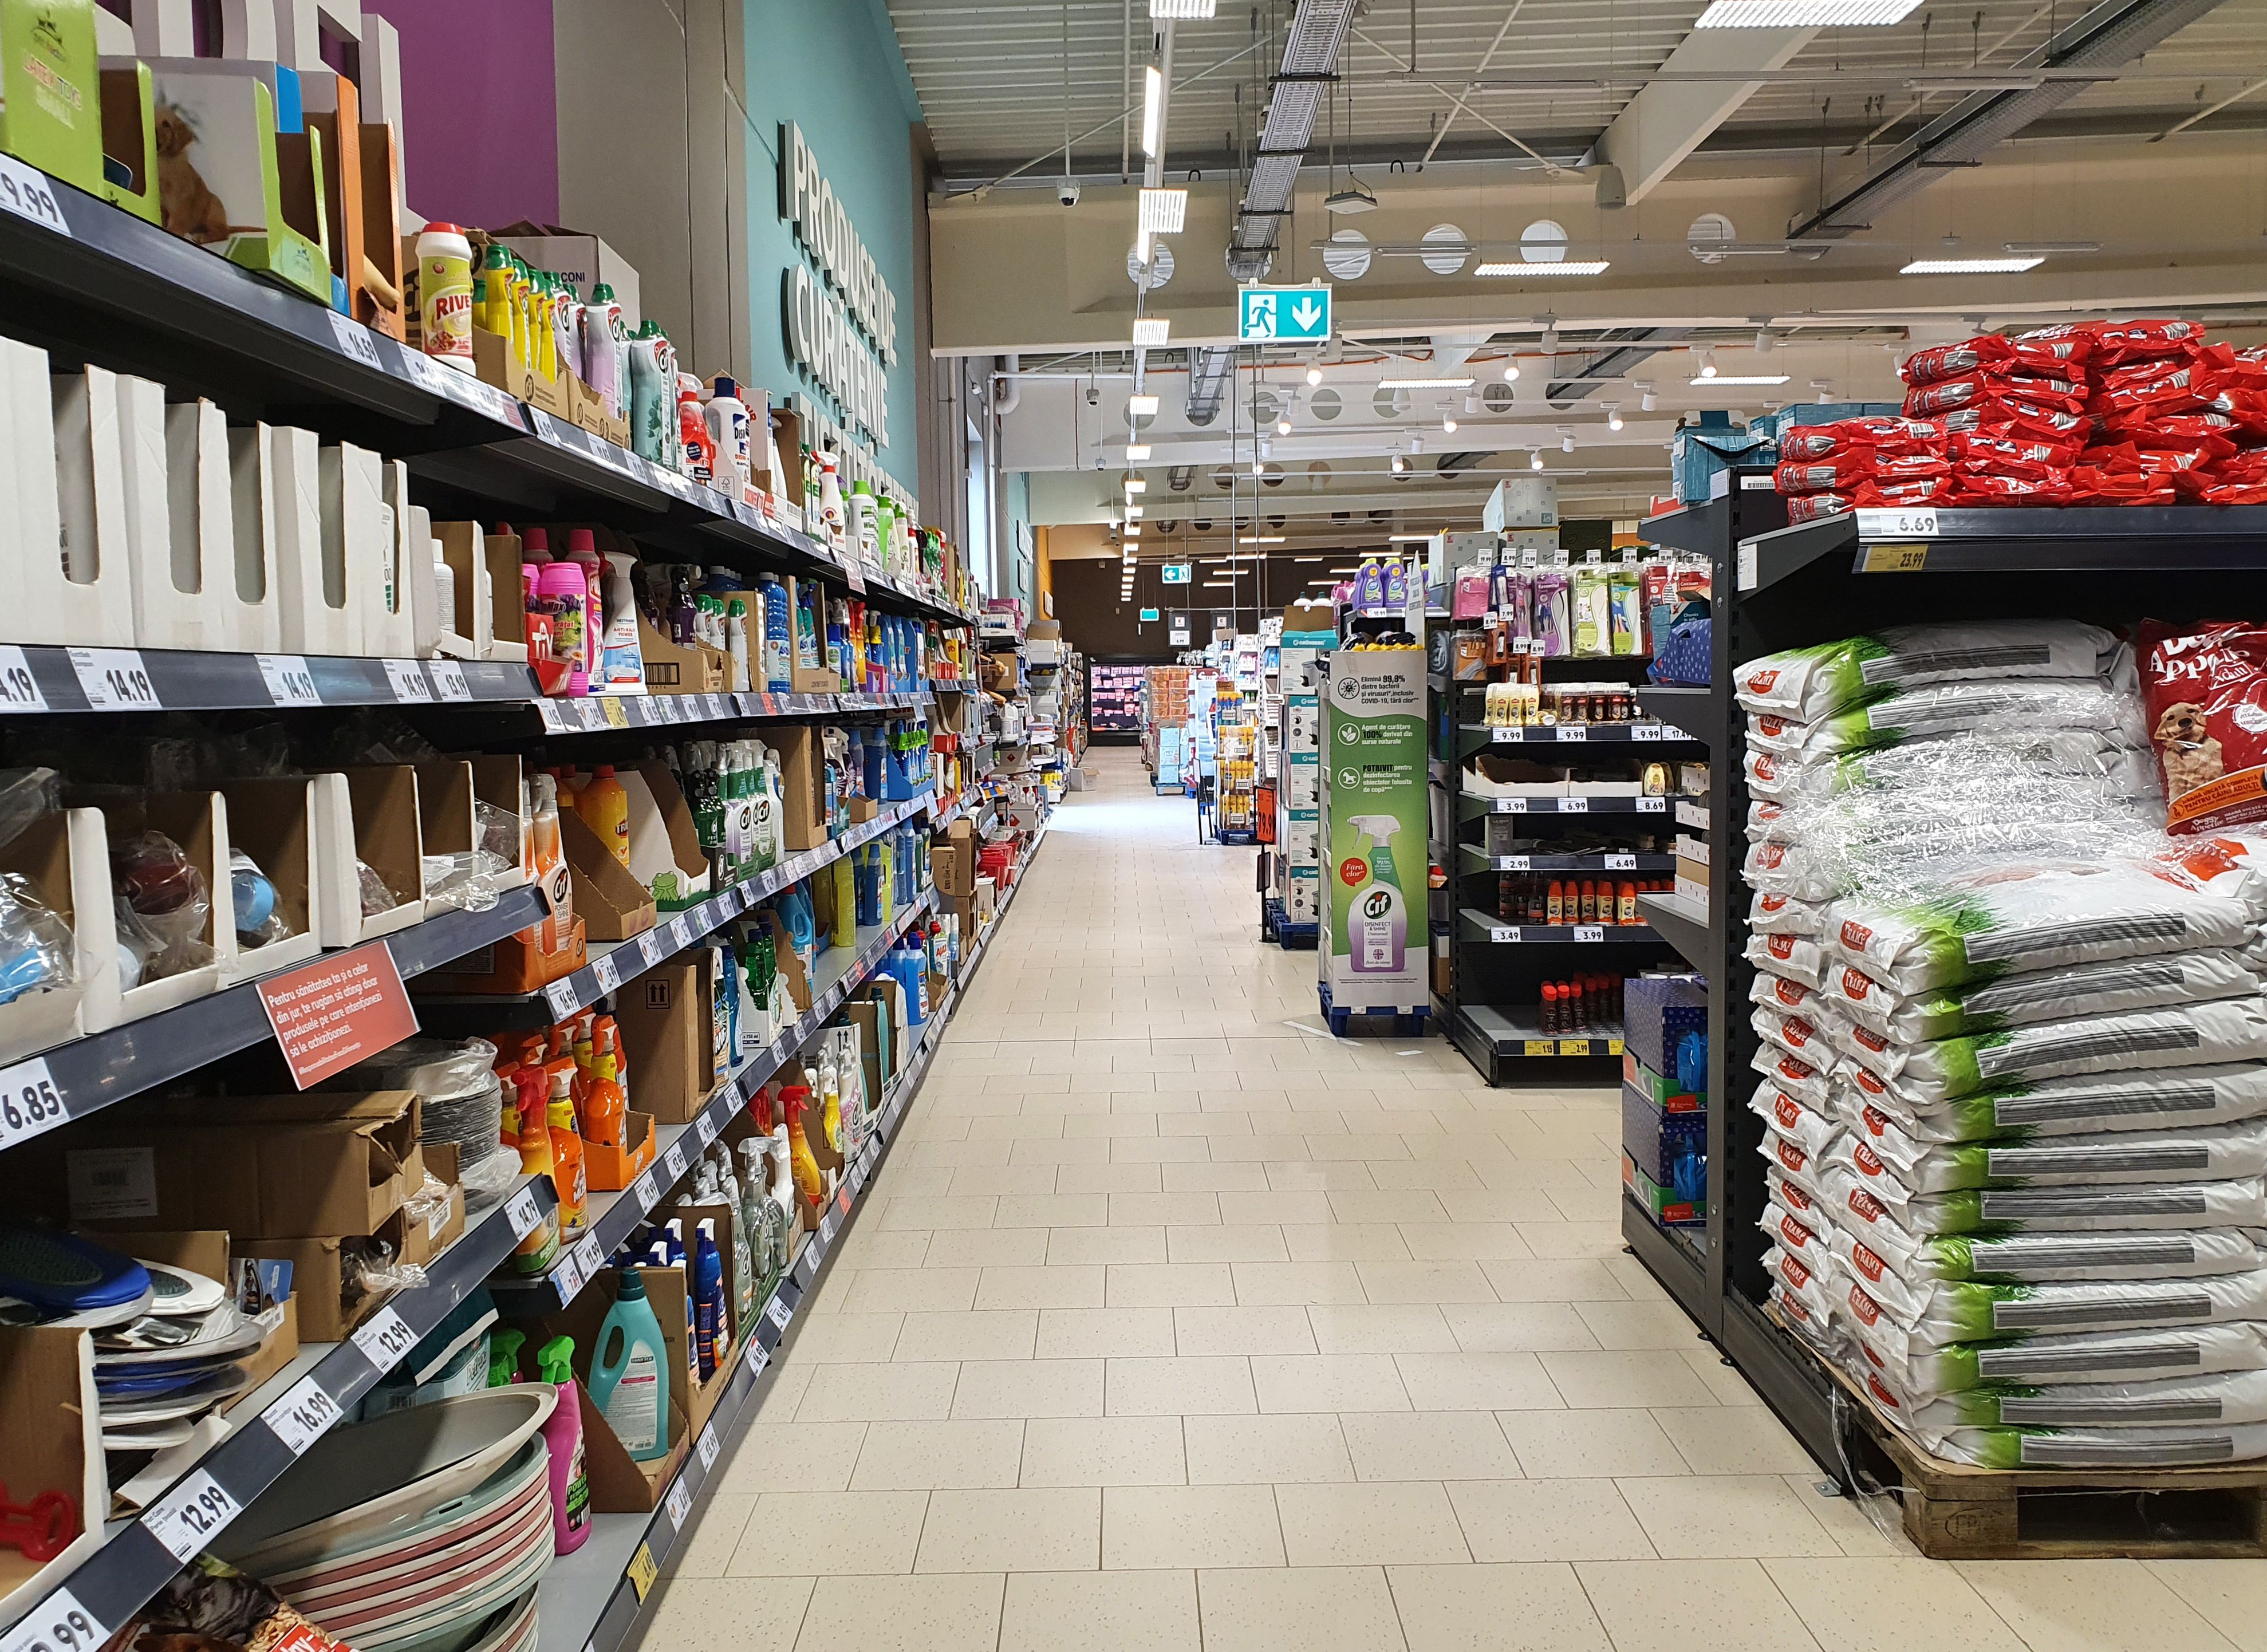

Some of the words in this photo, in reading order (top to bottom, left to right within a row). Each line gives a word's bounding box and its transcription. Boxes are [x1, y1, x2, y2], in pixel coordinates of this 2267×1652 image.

[784, 119, 878, 338] PRODUSE
[876, 272, 897, 368] DE
[561, 272, 585, 282] CONI
[436, 294, 471, 321] RIVE
[1899, 517, 1934, 532] 6.69
[1900, 552, 1924, 567] 23.99
[106, 669, 152, 701] 14.19
[282, 672, 315, 699] 14.19
[401, 673, 428, 696] 14.19
[1363, 730, 1382, 739] 100%
[1502, 732, 1520, 740] 9.99
[1566, 732, 1584, 740] 9.99
[1641, 731, 1659, 739] 9.99
[1568, 802, 1586, 810] 6.99
[1645, 802, 1663, 810] 8.69
[2185, 797, 2210, 808] PENTRU
[2192, 814, 2218, 826] Doggy
[1510, 861, 1528, 869] 2.99
[1617, 859, 1634, 868] 6.49
[554, 902, 569, 912] POWER
[1366, 894, 1389, 916] Cif
[1500, 932, 1519, 940] 3.49
[1583, 932, 1602, 940] 3.99
[267, 991, 295, 1008] Pentru
[295, 977, 332, 997] sănătatea
[331, 973, 341, 983] ta
[353, 963, 369, 976] celor
[1846, 971, 1867, 992] TRAMP
[276, 1011, 289, 1024] din
[287, 1008, 303, 1022] jur,
[301, 1003, 311, 1014] te
[311, 995, 335, 1010] rugăm
[343, 980, 363, 995] atingi
[362, 977, 379, 989] doar
[559, 989, 579, 1012] 16.99
[283, 1018, 320, 1044] produsele
[319, 1015, 329, 1028] pe
[329, 1008, 346, 1021] care
[1787, 1020, 1808, 1041] TRAMP
[299, 1041, 308, 1052] le
[1543, 1044, 1552, 1053] 1.15
[1576, 1044, 1588, 1053] 2.99
[2, 1080, 60, 1130] 6.85
[518, 1199, 538, 1228] 14.79
[1784, 1218, 1807, 1240] TRAMP
[586, 1241, 601, 1267] 11.99
[1856, 1244, 1880, 1274] TRAMP
[1783, 1258, 1805, 1282] TRAMP
[1851, 1289, 1876, 1318] TRAMP
[379, 1320, 412, 1355] 12.99
[293, 1391, 334, 1432] 16.99
[180, 1486, 230, 1535] 12.99
